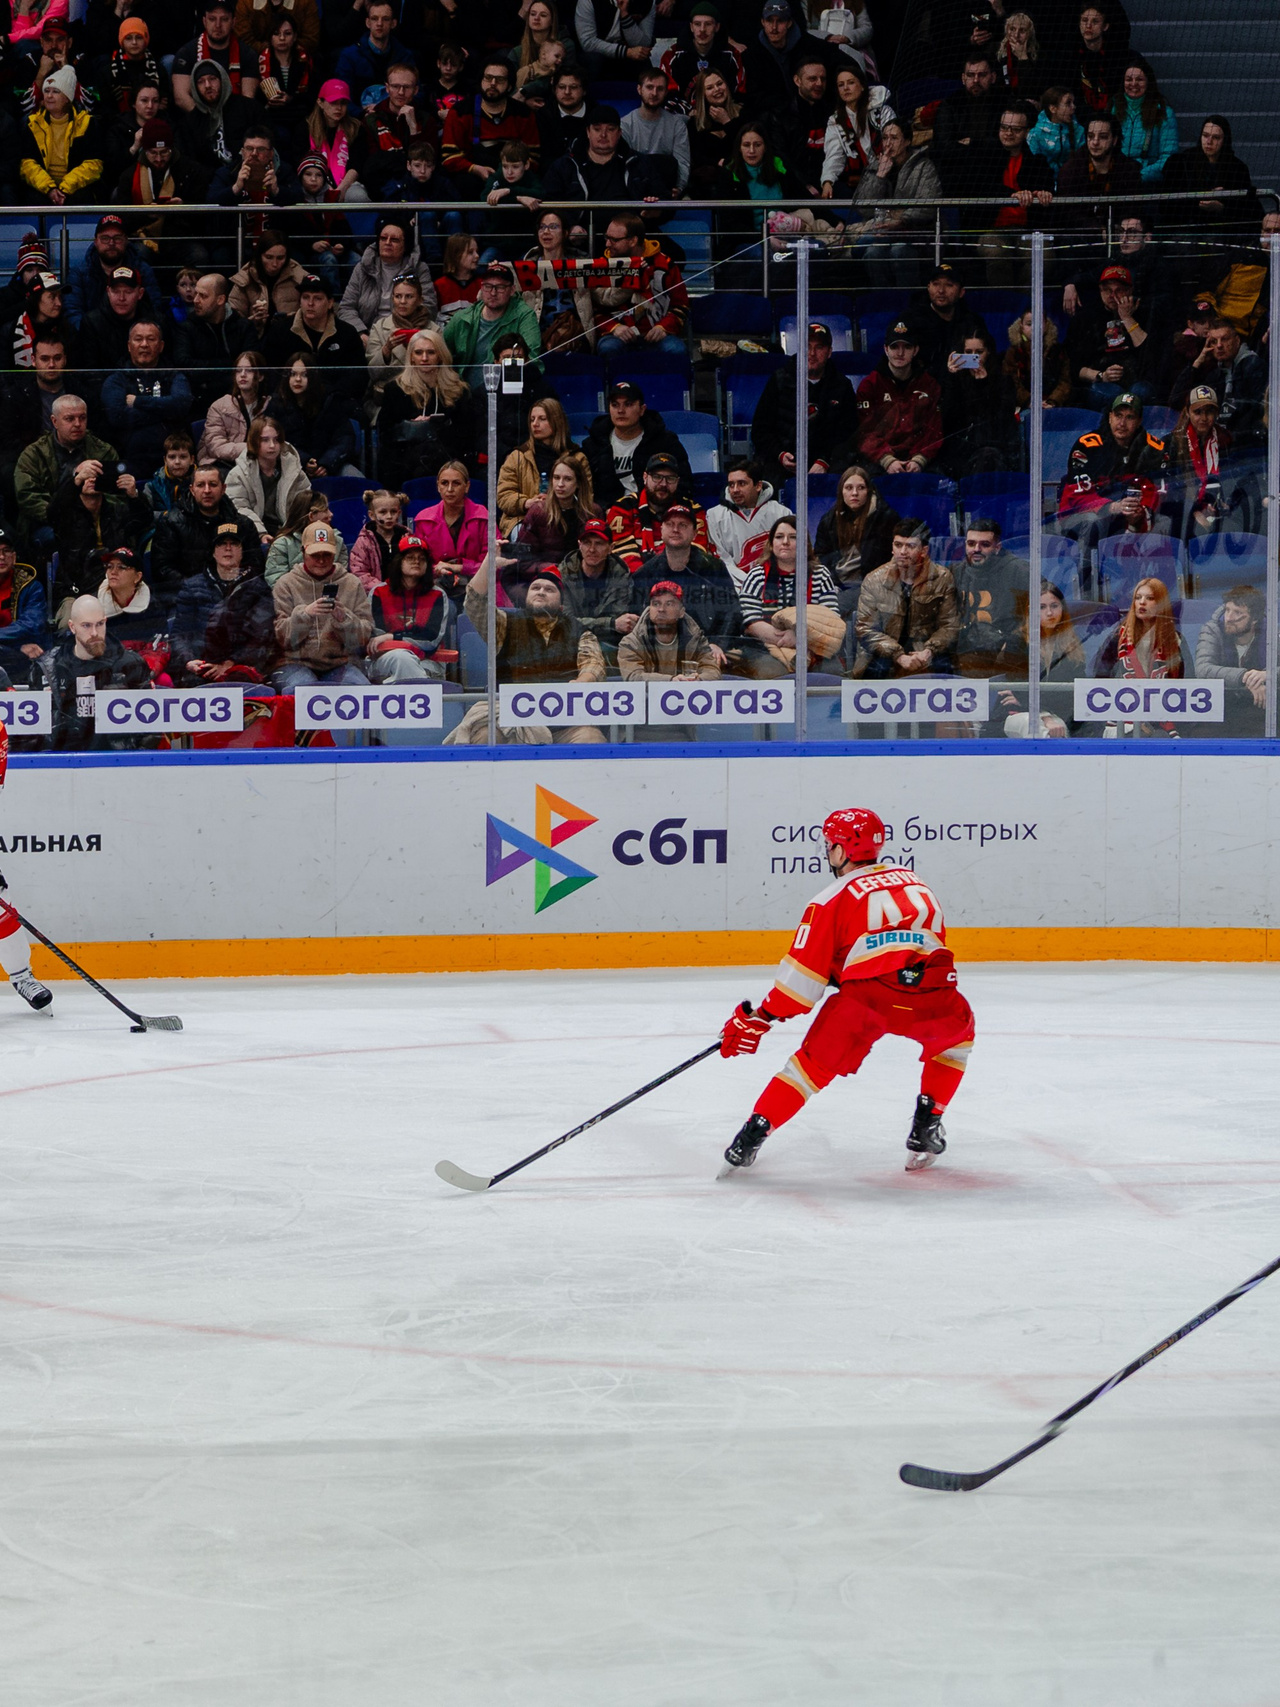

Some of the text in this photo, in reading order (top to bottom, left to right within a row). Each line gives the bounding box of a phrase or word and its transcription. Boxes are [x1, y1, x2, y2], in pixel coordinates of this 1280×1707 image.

[107, 698, 231, 725] согаз
[306, 694, 431, 721] согаз
[511, 691, 634, 717] согаз
[660, 690, 783, 716] согаз
[853, 687, 978, 713] согаз
[1087, 687, 1211, 713] согаз
[612, 817, 728, 866] сбп
[905, 815, 1038, 848] быстрых
[847, 869, 924, 901] LEFEBVR
[865, 930, 925, 950] SIBUR
